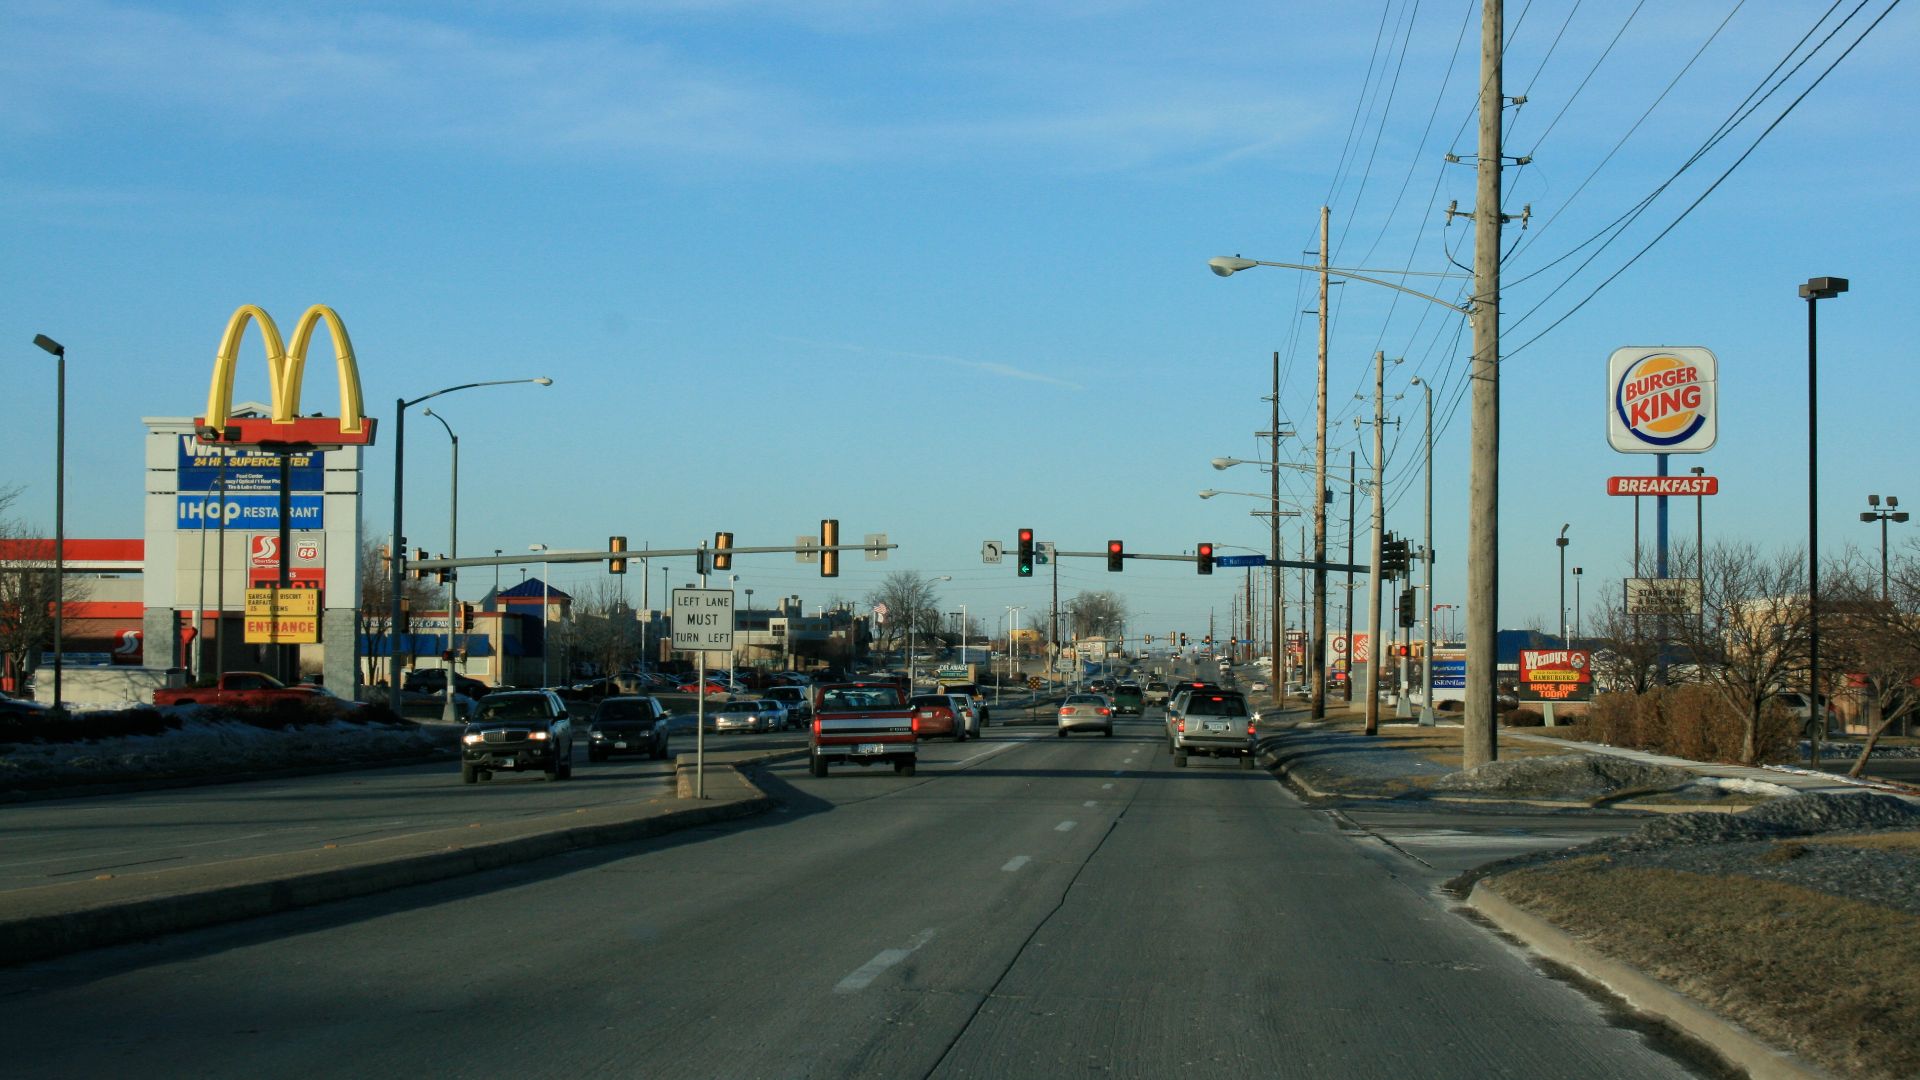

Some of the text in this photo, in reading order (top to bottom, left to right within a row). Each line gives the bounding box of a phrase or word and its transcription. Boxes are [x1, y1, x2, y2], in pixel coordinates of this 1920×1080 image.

[1625, 366, 1698, 402] BURGER
[1631, 385, 1701, 428] KING
[193, 457, 206, 467] 24
[229, 457, 310, 467] SUPERCETER
[1618, 479, 1710, 493] BREAKFAST
[244, 507, 319, 518] RESTARANT
[300, 548, 315, 557] 66
[677, 596, 729, 607] LEFT LANE
[687, 613, 718, 626] MUST
[247, 621, 315, 633] ENTRANCE
[675, 632, 731, 643] TURN LEFT
[1530, 683, 1578, 691] HAVE ONE
[1539, 690, 1569, 698] TODAY
